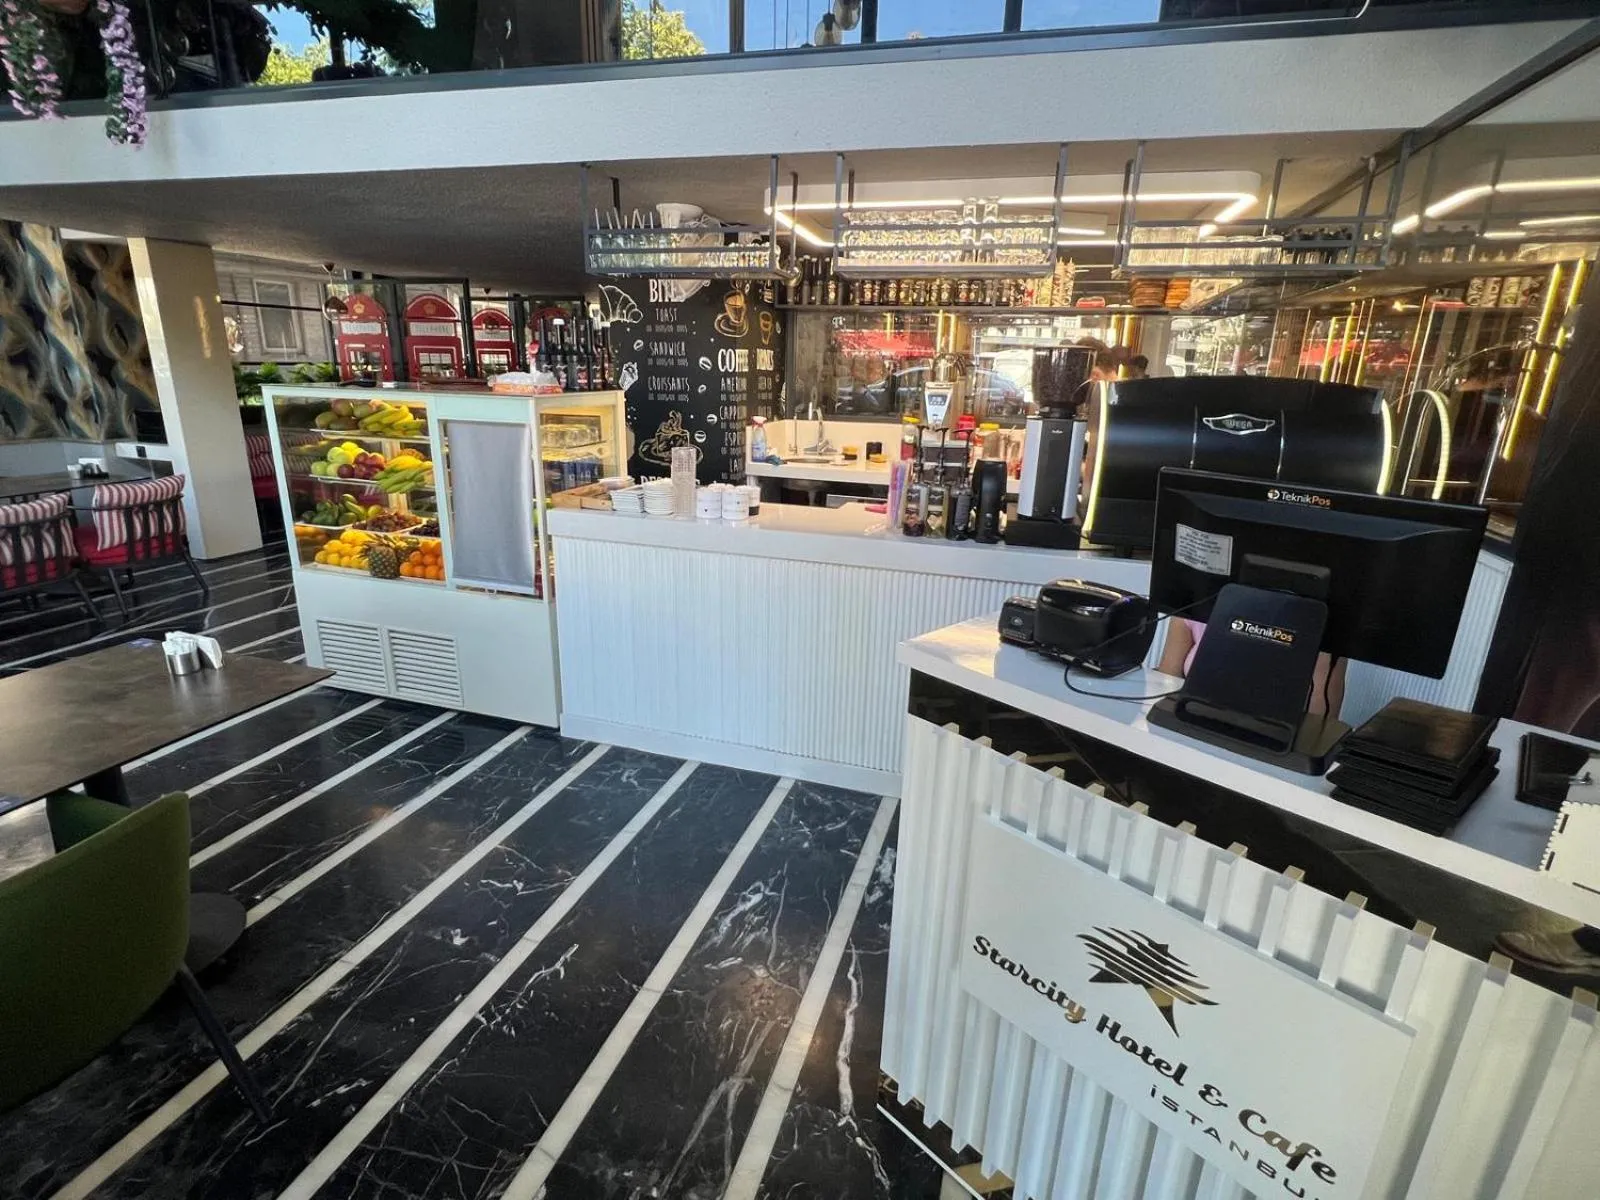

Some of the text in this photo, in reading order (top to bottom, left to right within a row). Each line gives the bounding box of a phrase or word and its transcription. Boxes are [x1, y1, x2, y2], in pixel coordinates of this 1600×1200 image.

[649, 340, 687, 357] SANDWICH
[647, 375, 691, 392] CROISSANTS
[1280, 490, 1332, 507] TeknikPos
[1244, 621, 1294, 643] TeknikPos
[972, 934, 1337, 1185] Starcity Hotel & Cafe
